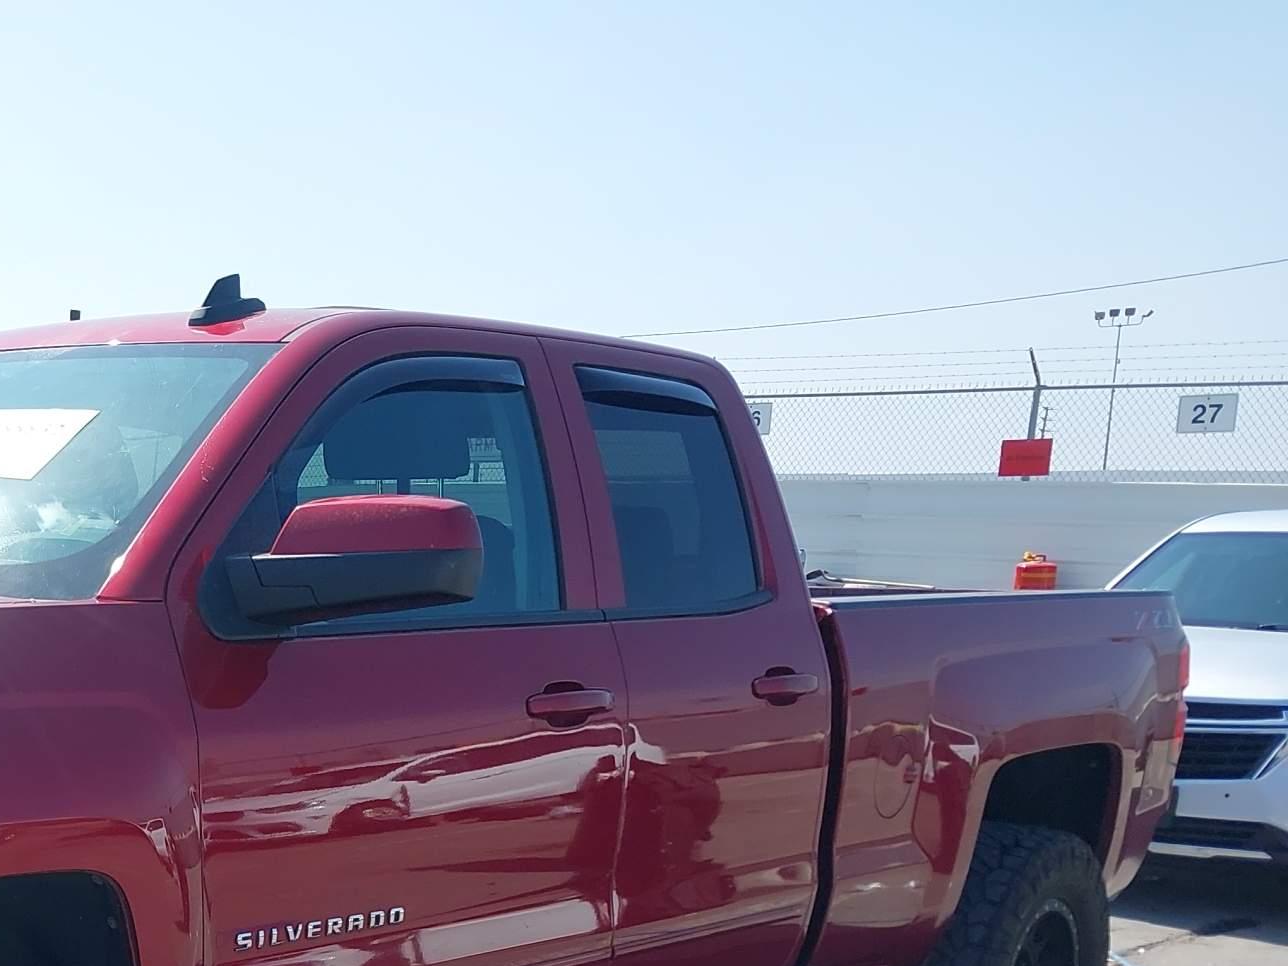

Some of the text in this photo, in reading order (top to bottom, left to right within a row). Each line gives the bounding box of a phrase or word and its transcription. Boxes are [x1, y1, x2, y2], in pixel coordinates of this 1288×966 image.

[752, 410, 761, 427] 6
[1191, 403, 1224, 425] 27
[235, 906, 405, 951] SILVERADO
